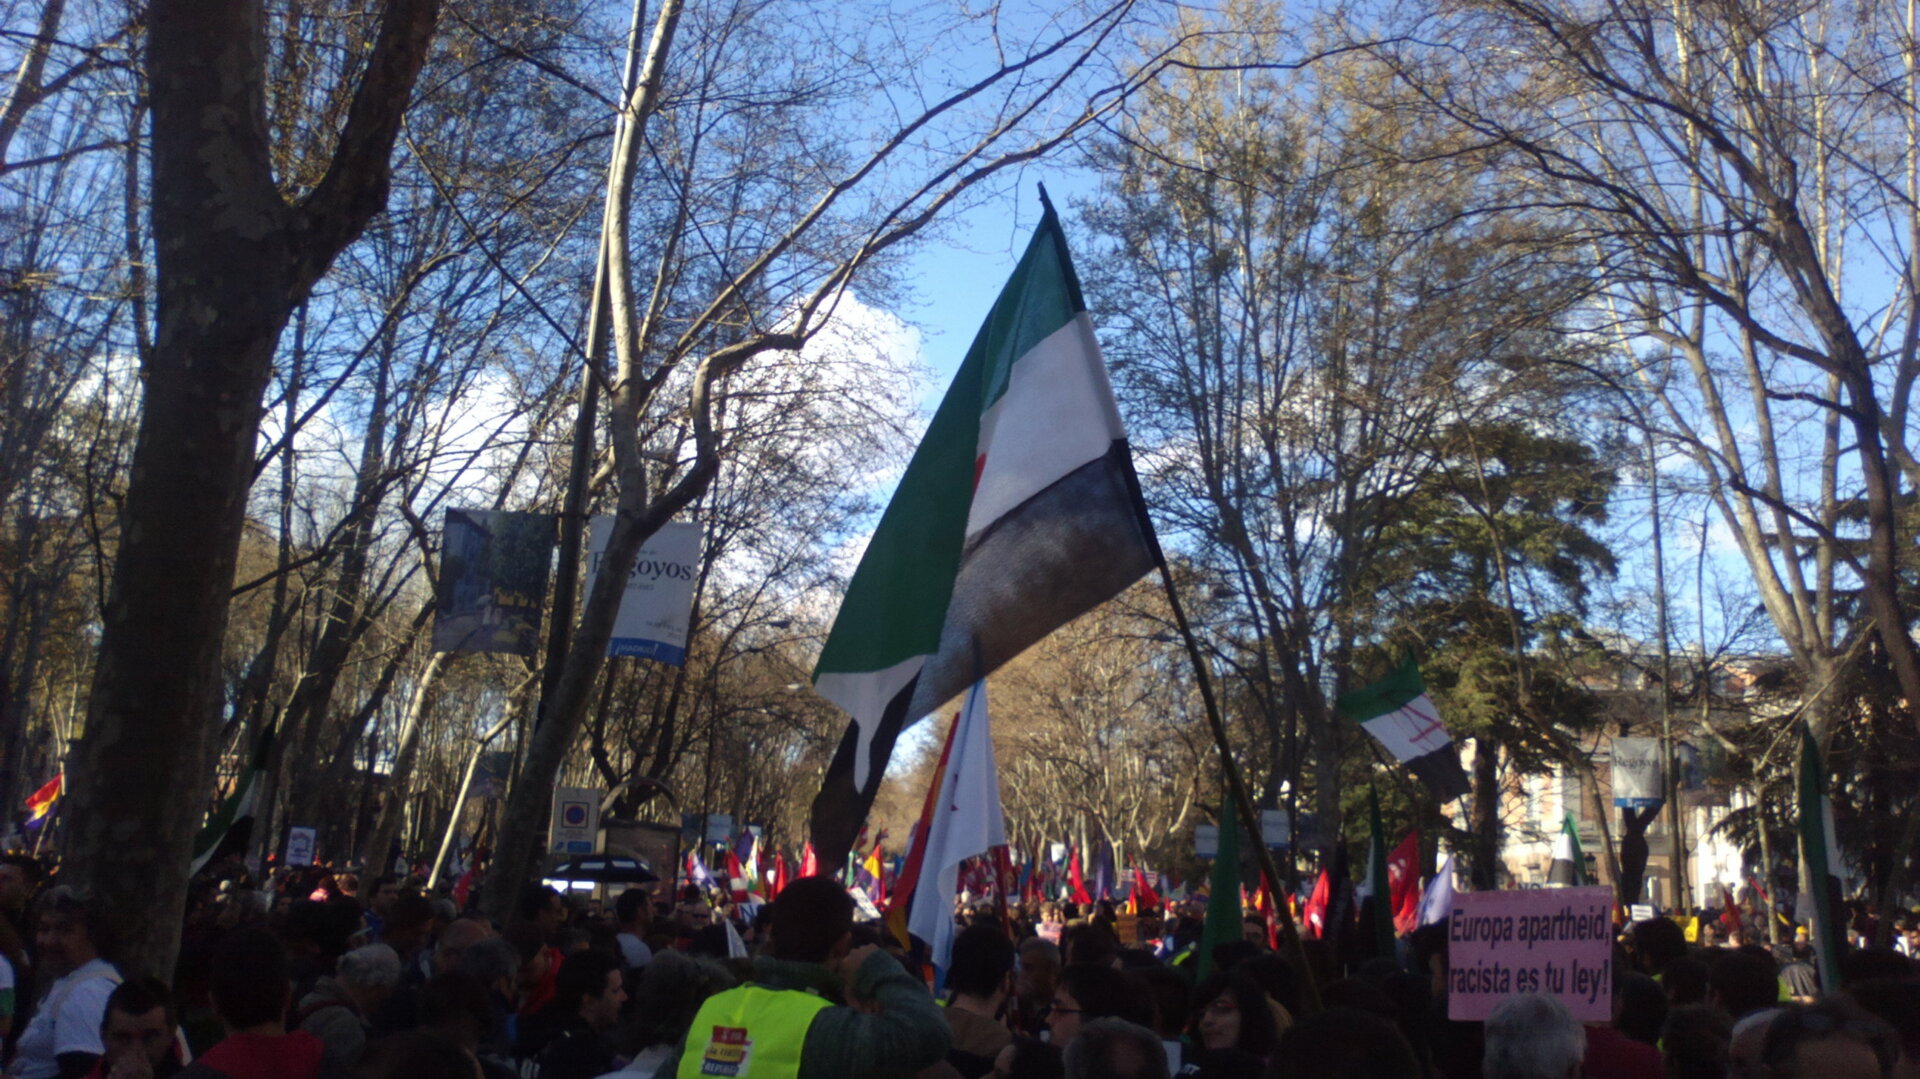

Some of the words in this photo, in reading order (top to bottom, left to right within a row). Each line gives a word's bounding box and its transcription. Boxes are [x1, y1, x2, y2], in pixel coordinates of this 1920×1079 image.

[592, 551, 692, 581] goyos
[1451, 909, 1513, 949] Europa
[1518, 905, 1610, 949] apartheid,
[1450, 960, 1510, 994] racista
[1517, 969, 1539, 993] es
[1546, 961, 1564, 994] tu
[1572, 959, 1609, 1004] ley!
